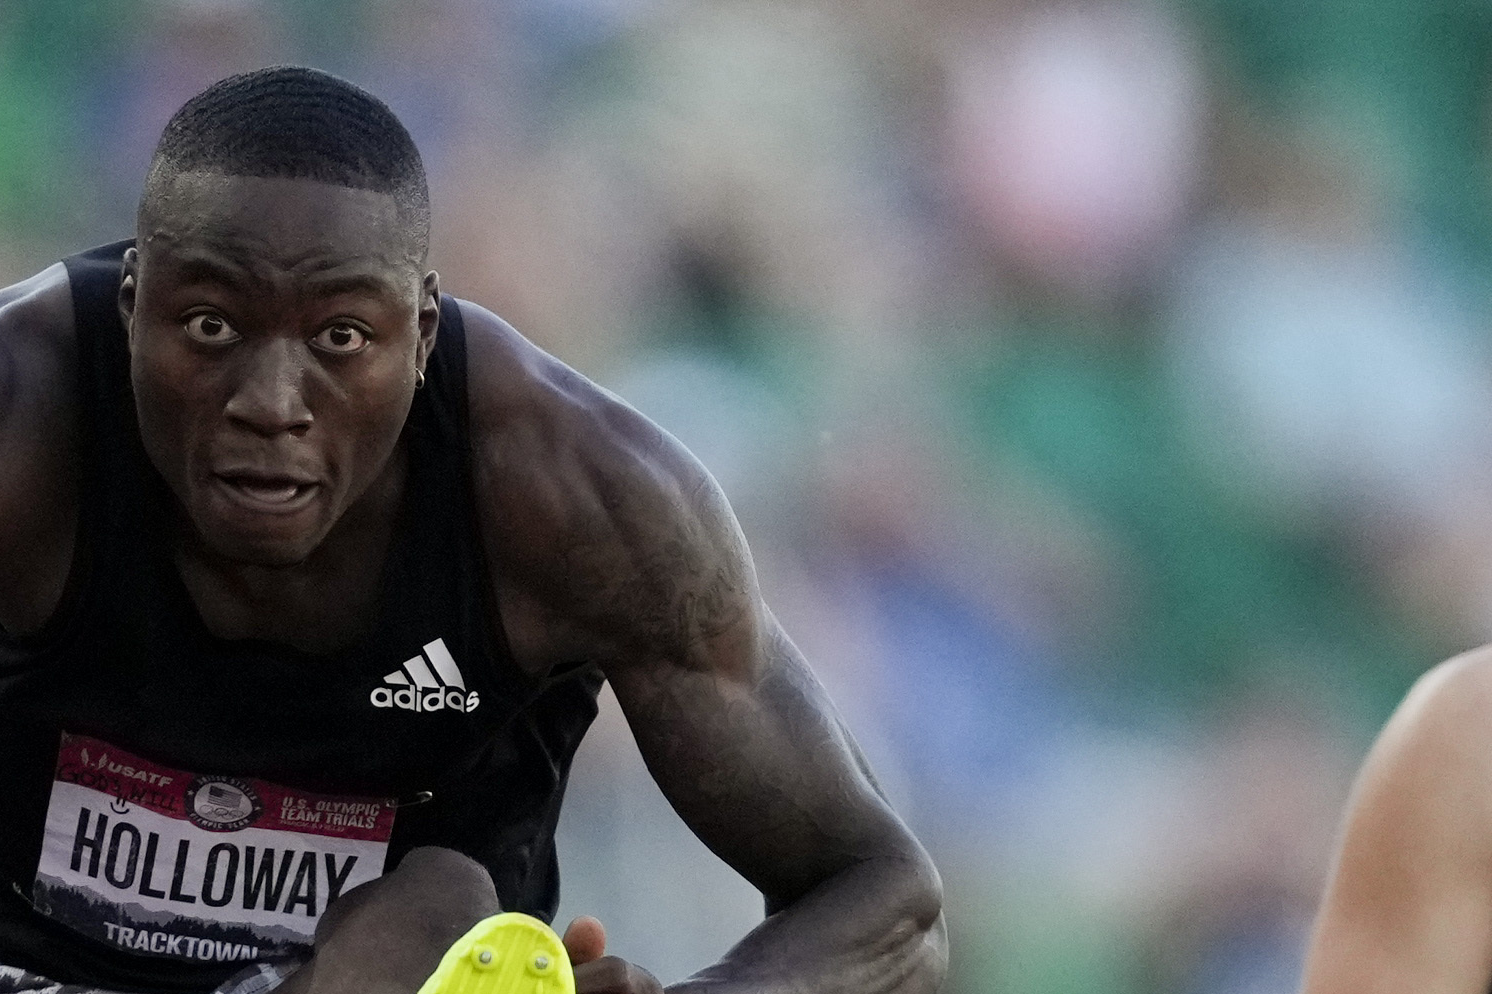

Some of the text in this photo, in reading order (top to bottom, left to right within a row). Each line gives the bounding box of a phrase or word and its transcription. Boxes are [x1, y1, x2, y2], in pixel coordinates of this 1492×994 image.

[370, 684, 480, 713] adidas
[108, 761, 174, 787] USATF
[281, 807, 376, 829] TEAM TRIALS
[282, 796, 380, 817] U.S. OLYMPIC
[69, 807, 359, 917] HOLLOWAY
[103, 920, 259, 962] TRACKTOWN
